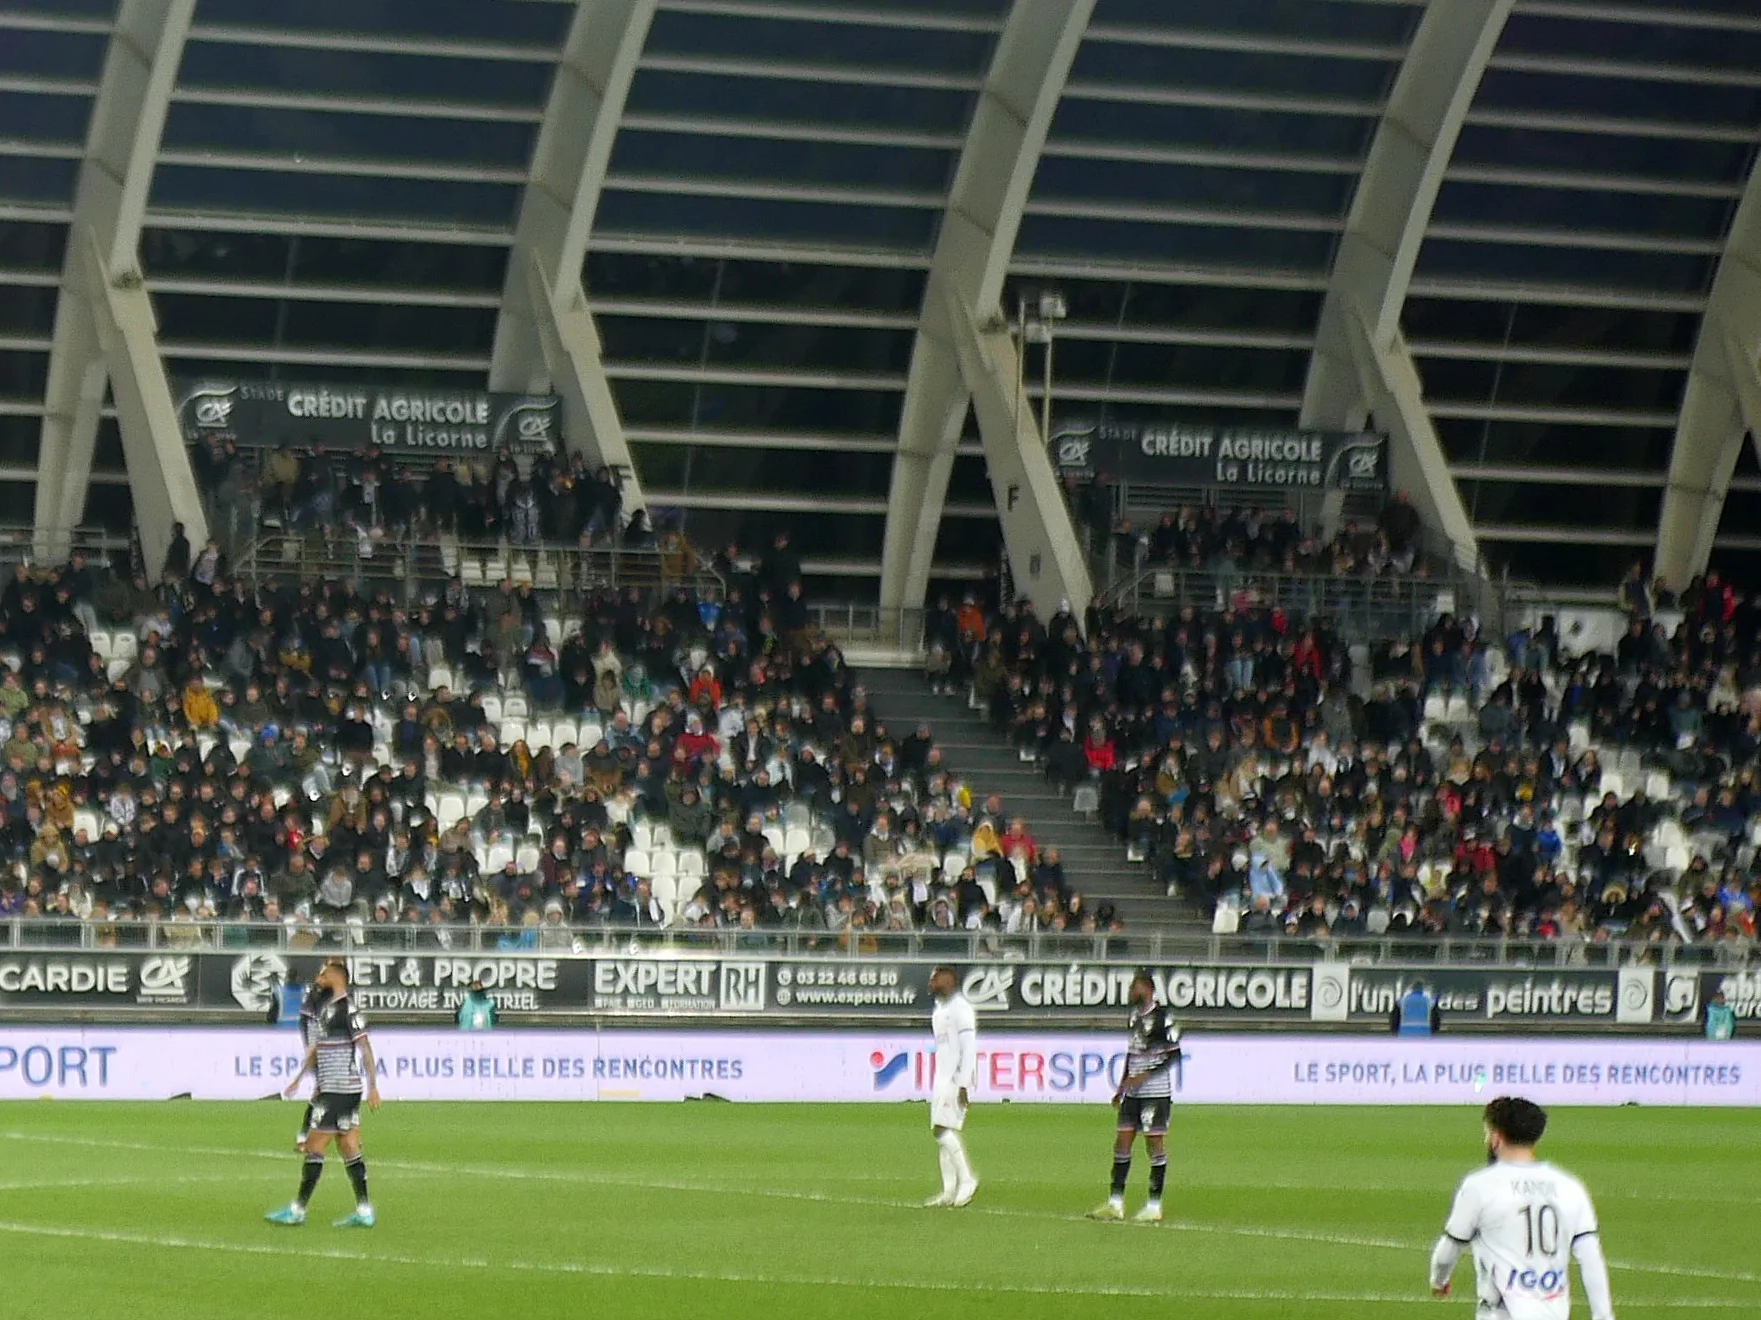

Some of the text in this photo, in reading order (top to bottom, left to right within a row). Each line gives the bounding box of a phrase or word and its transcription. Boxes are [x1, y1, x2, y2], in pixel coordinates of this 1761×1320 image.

[287, 390, 366, 420] CRÉDIT
[373, 397, 489, 424] AGRICOLE
[370, 422, 396, 445] La
[405, 423, 489, 449] Licorne
[1140, 430, 1212, 457] CRÉDIT
[1218, 436, 1322, 462] AGRICOLE
[1216, 461, 1322, 485] La Licorne
[399, 957, 421, 987] &
[434, 958, 557, 991] PROPRE
[594, 960, 718, 996] EXPERT
[725, 966, 761, 1007] RH
[796, 970, 816, 985] 03
[817, 971, 835, 985] 22
[1020, 964, 1308, 1009] CRÉDIT AGRICOLE
[443, 990, 539, 1011] INTRIEL
[795, 988, 916, 1006] www.expertrh.fr
[1437, 992, 1479, 1010] des
[1487, 976, 1613, 1018] peintres
[234, 1056, 262, 1077] LE
[395, 1057, 454, 1078] PLUS
[462, 1057, 533, 1078] BELLE
[543, 1058, 585, 1079] DES
[592, 1057, 744, 1080] RENCONTRES
[1294, 1062, 1741, 1086] LE SPORT, LA PLUS BELLE DES RENCONTRES
[1518, 1204, 1559, 1257] 10
